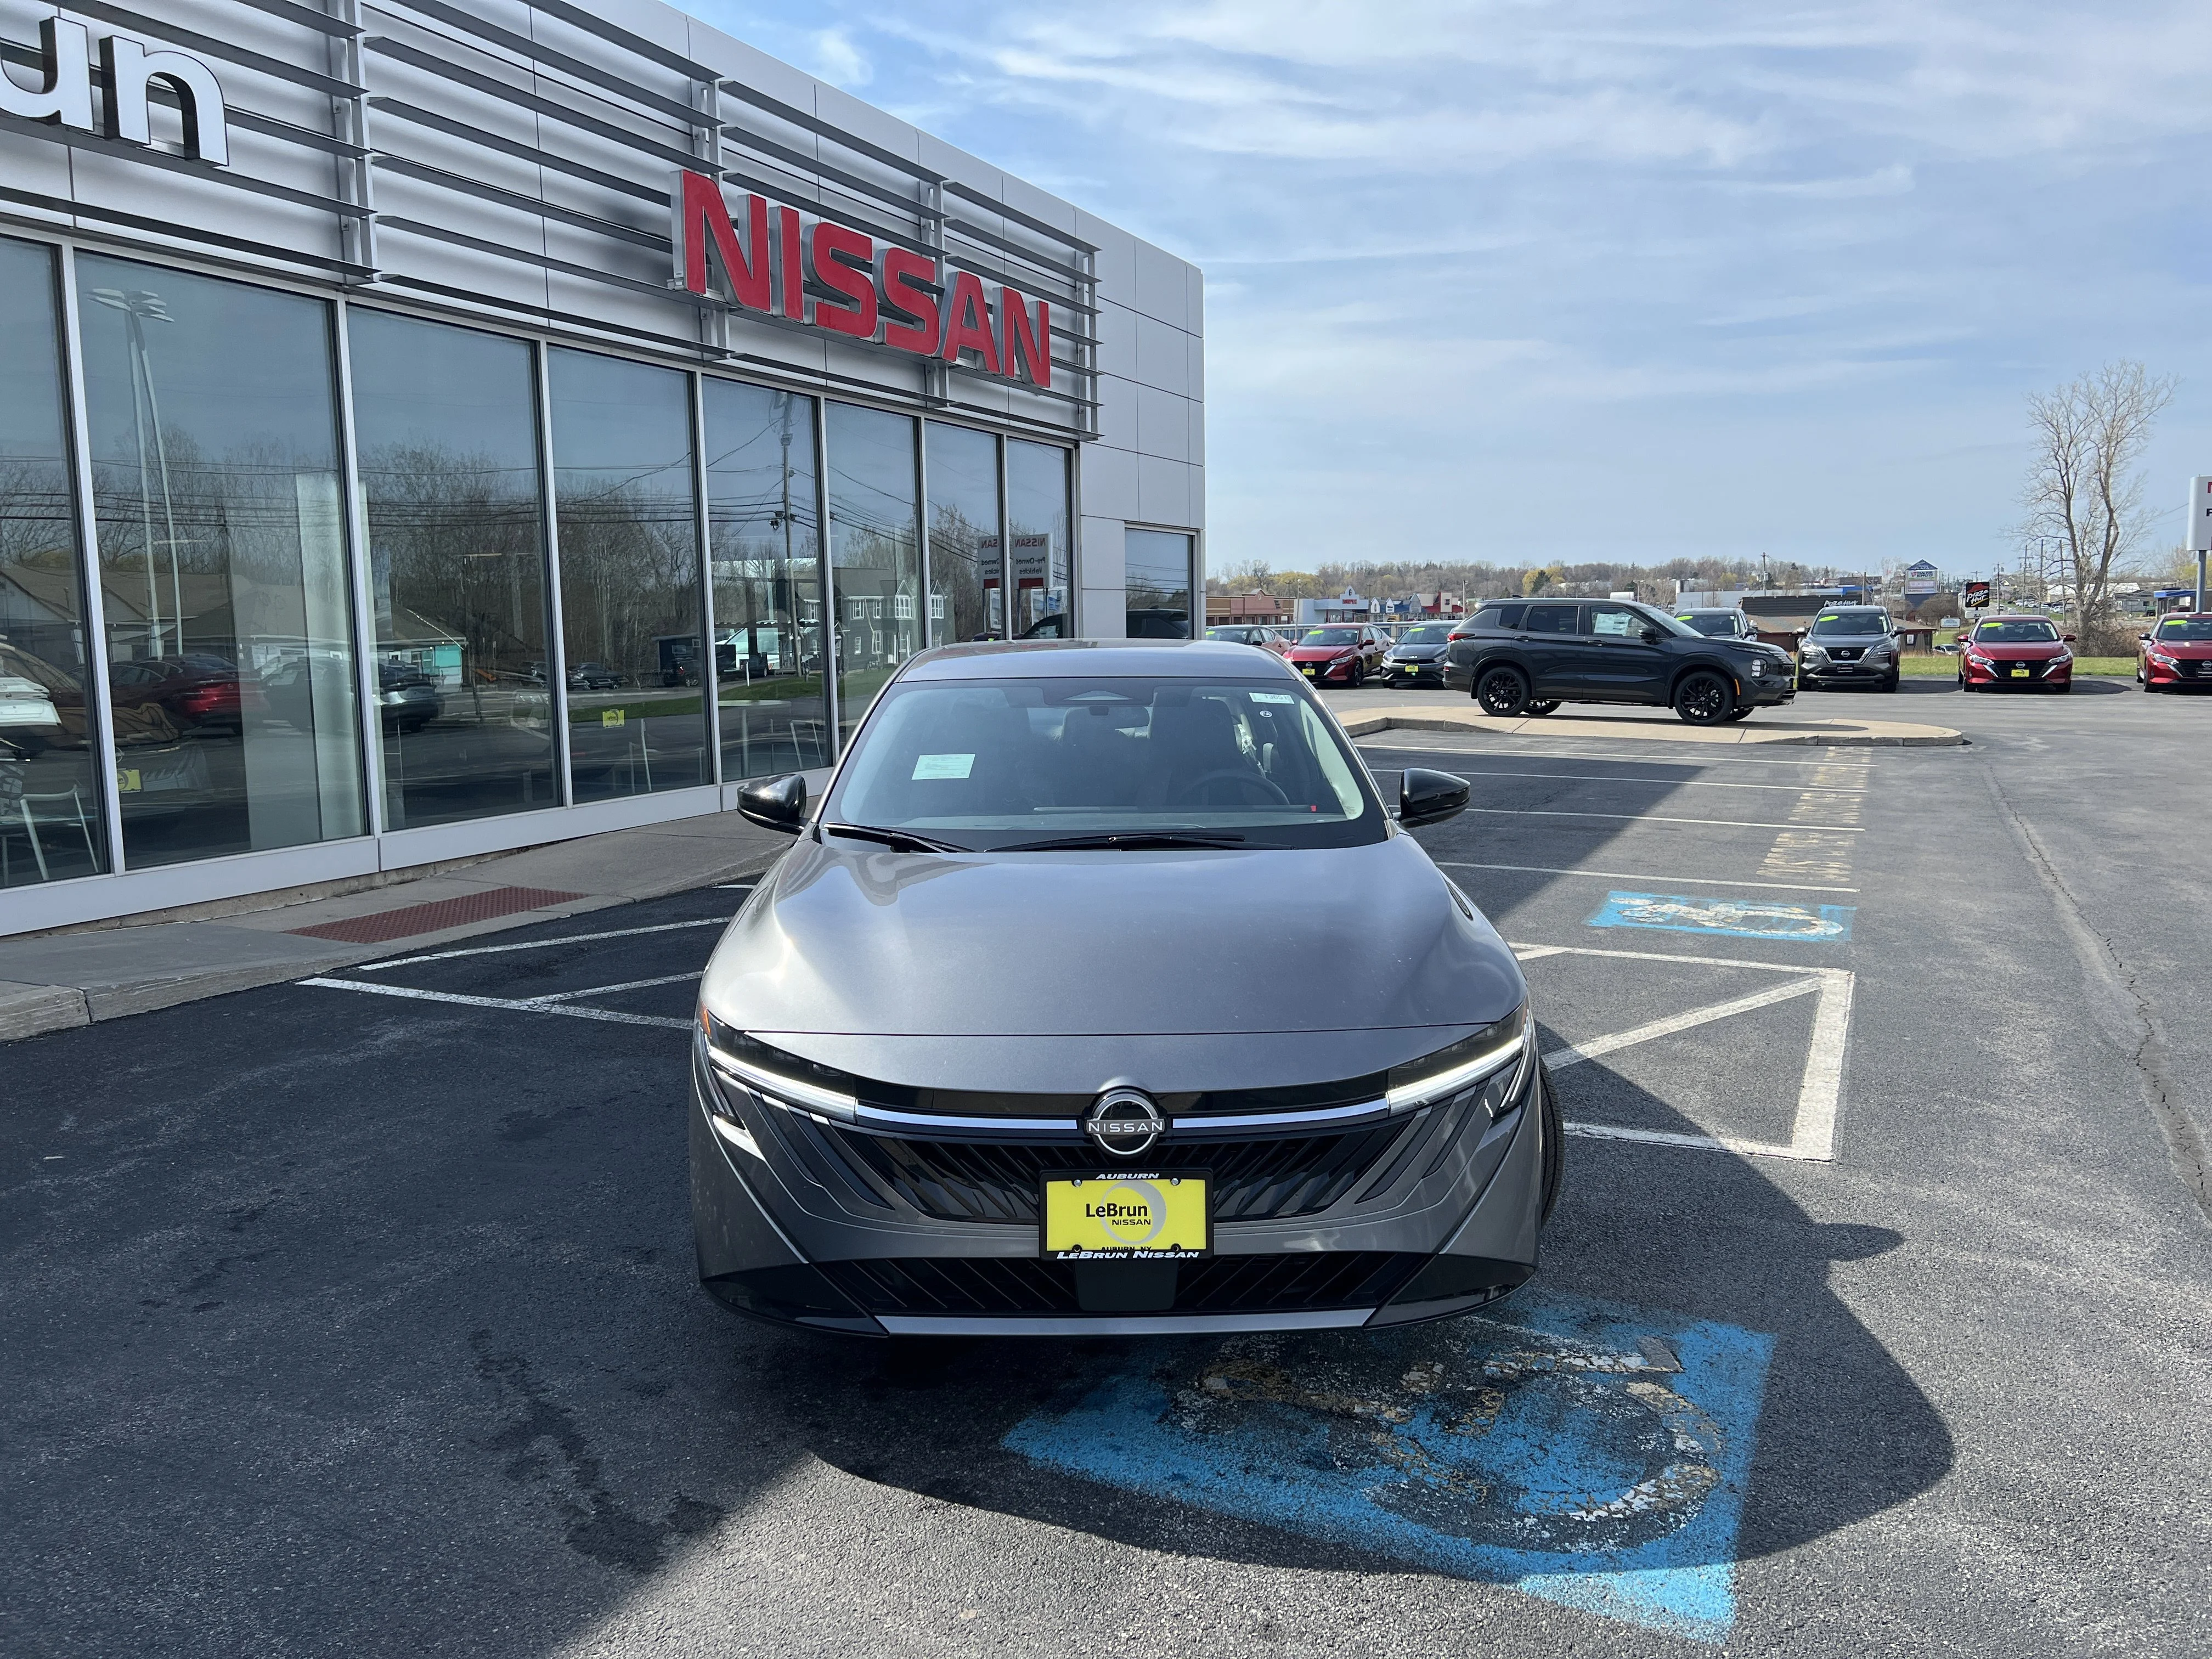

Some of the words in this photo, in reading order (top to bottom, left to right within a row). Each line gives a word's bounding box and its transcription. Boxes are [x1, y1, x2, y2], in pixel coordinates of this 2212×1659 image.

[672, 169, 1051, 388] NISSAN
[1966, 590, 1989, 602] Pizza
[1971, 595, 1987, 604] Hut
[1088, 1121, 1162, 1132] NISSAN
[1086, 1203, 1147, 1217] LeBrun
